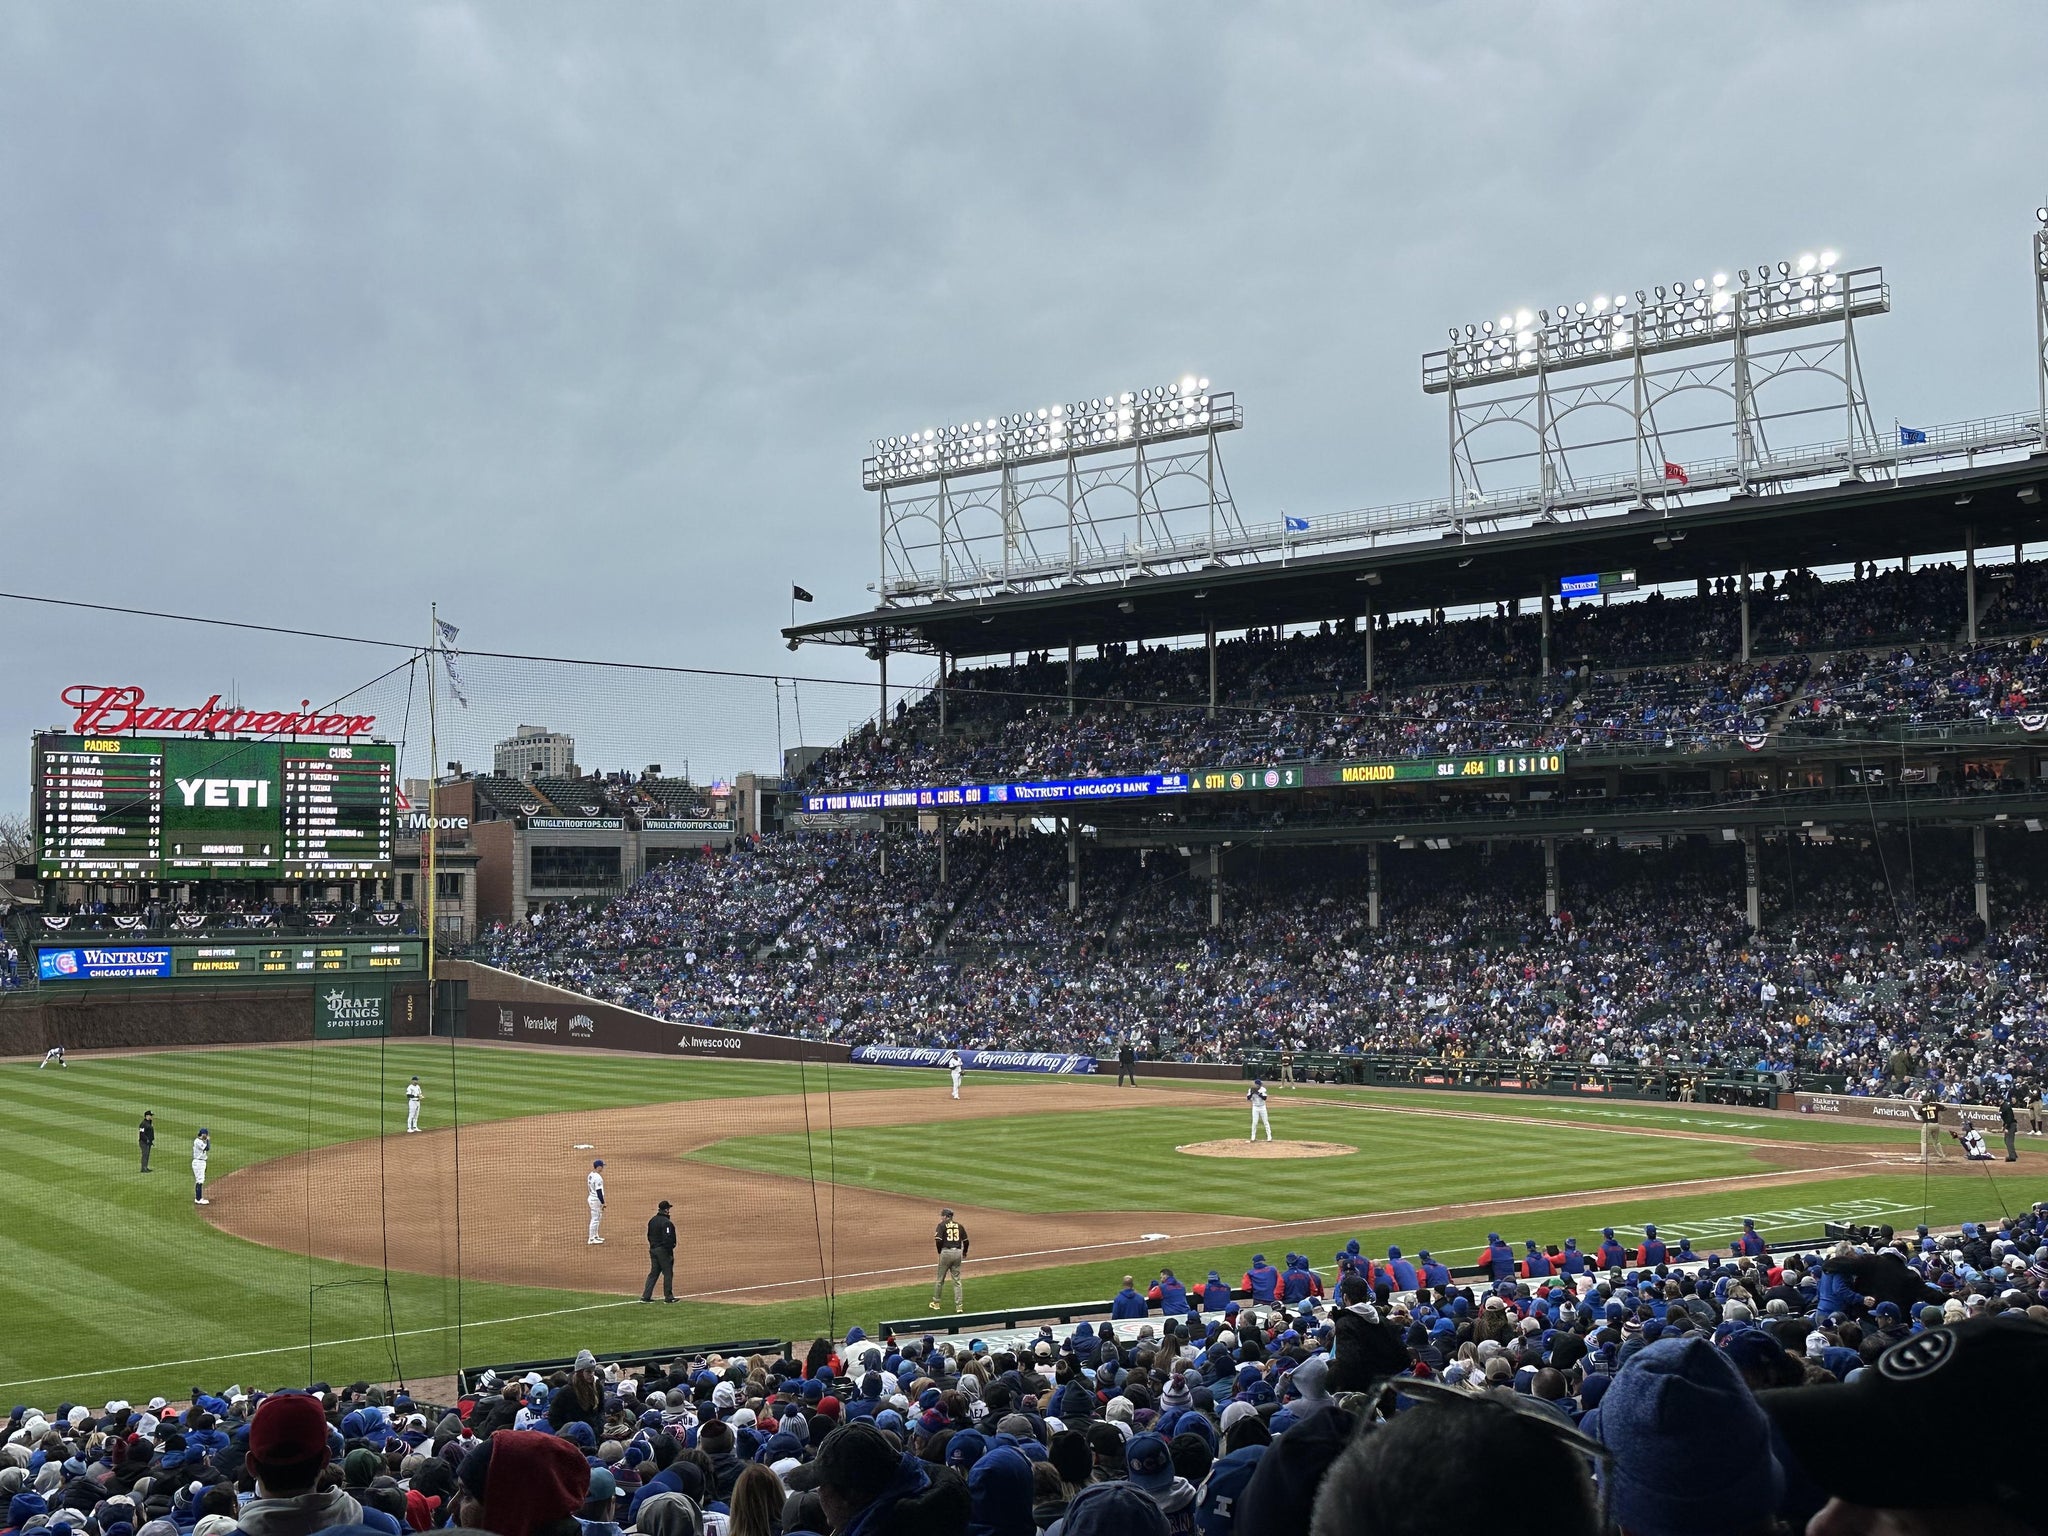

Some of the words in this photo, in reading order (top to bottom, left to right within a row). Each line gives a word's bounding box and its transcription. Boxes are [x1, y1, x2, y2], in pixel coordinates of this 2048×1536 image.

[1562, 581, 1598, 590] WINTRUST
[62, 685, 376, 736] Budweiser
[84, 740, 120, 752] PADRES
[330, 748, 353, 759] CUBS
[1437, 764, 1454, 776] SLG
[1461, 761, 1484, 776] .464
[1497, 759, 1505, 773] B
[1519, 758, 1526, 772] S
[1286, 771, 1293, 784] 3
[1342, 765, 1395, 782] MACHADO
[1205, 776, 1224, 789] 9TH
[174, 778, 268, 807] YETI
[1014, 786, 1068, 798] WINTRUST
[1073, 783, 1121, 796] CHICAGO'S
[1123, 782, 1149, 793] BANK
[809, 798, 824, 810] GET
[826, 797, 847, 810] YOUR
[849, 795, 882, 809] WALLET
[884, 792, 917, 807] SINGING
[920, 792, 935, 805] GO,
[937, 790, 963, 804] CUBS,
[966, 789, 981, 802] GO!
[409, 813, 469, 829] Moore
[533, 818, 619, 828] WRIGLEYROOFTOPS.COM
[646, 819, 729, 829] WRIGLEYROOFTOPS.COM
[174, 844, 181, 855] 1
[201, 845, 224, 853] MOUND
[225, 845, 244, 853] VISITS
[262, 845, 270, 855] 4
[83, 950, 165, 964] WINTRUST
[90, 969, 133, 977] CHICAGO'S
[135, 968, 158, 976] BANK
[193, 962, 211, 971] RYAN
[212, 961, 240, 970] PRESSLY
[327, 998, 382, 1011] DRAFT
[334, 1008, 380, 1019] KINGS
[327, 1019, 384, 1028] SPORTSBOOK
[523, 1015, 543, 1030] Vienna
[544, 1017, 558, 1034] Beef
[569, 1014, 594, 1033] MARQUEE
[691, 1037, 722, 1048] Invesco
[723, 1038, 741, 1049] QQQ
[862, 1047, 909, 1064] Reynolds
[910, 1048, 940, 1064] Wrap
[973, 1051, 1025, 1069] Reynolds
[1027, 1053, 1062, 1071] Wrap
[1812, 1097, 1839, 1105] Maker's
[1873, 1106, 1909, 1118] American
[1604, 1197, 1915, 1240] WINTRUST
[946, 1228, 960, 1241] 33
